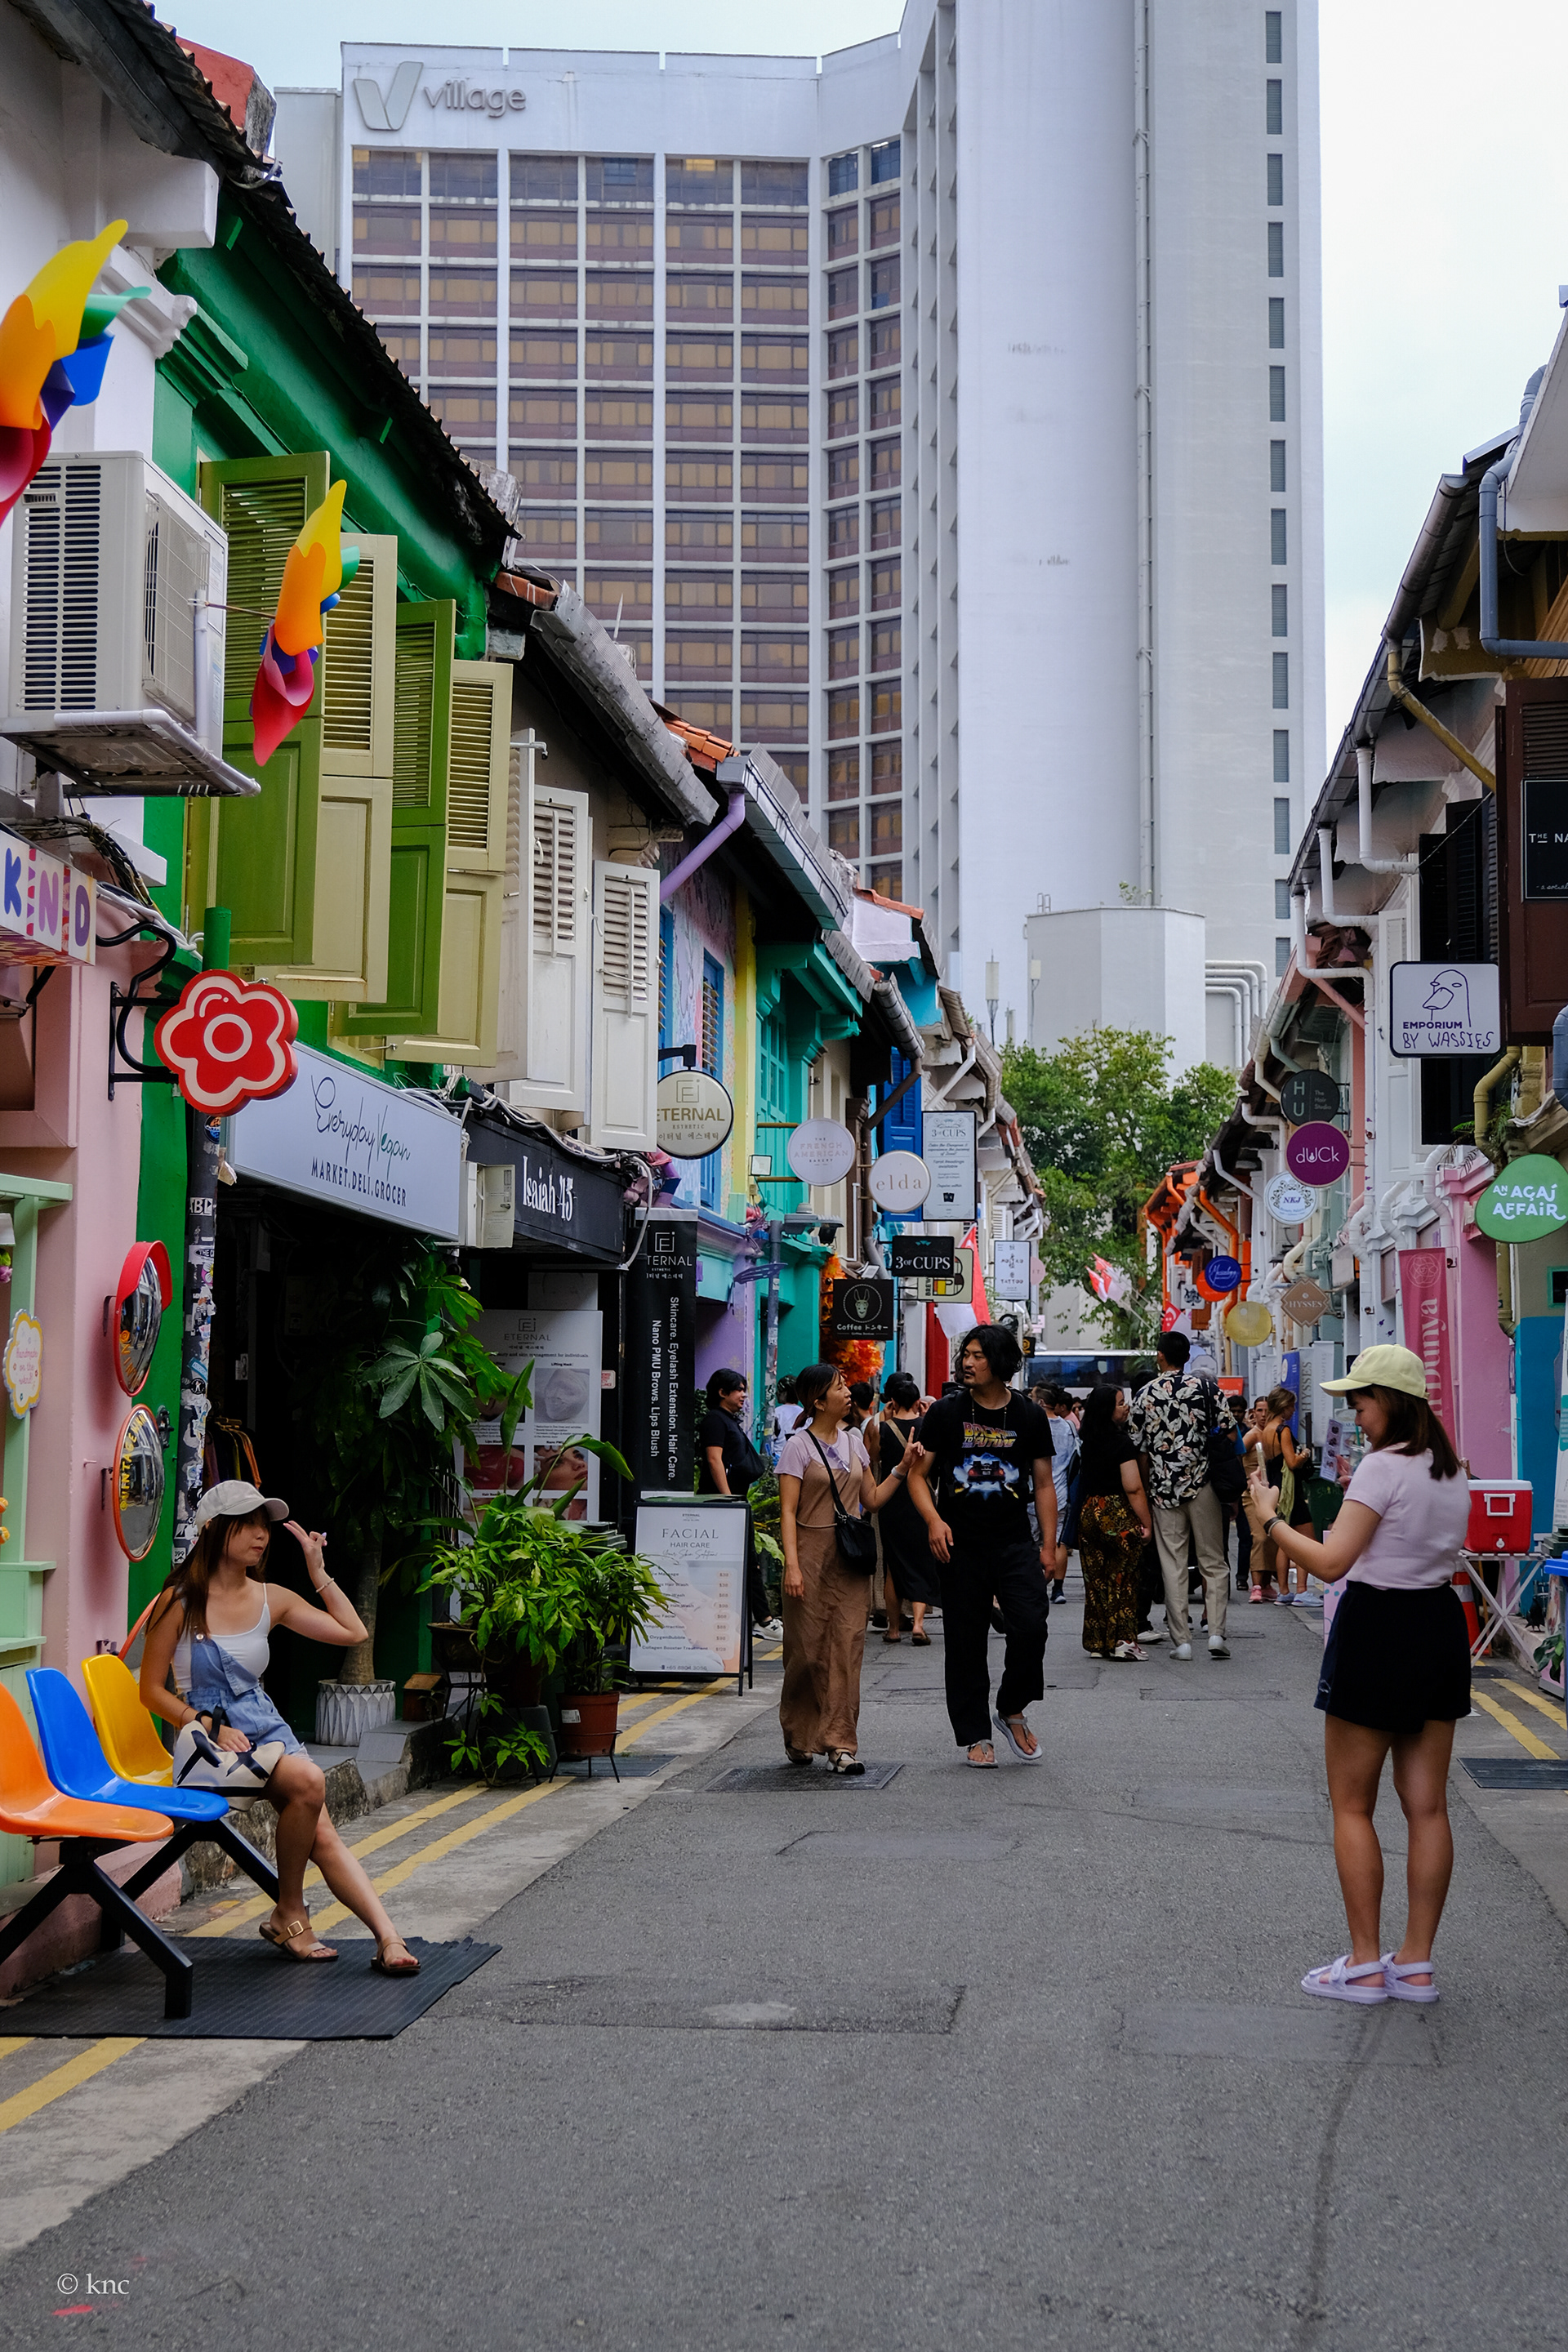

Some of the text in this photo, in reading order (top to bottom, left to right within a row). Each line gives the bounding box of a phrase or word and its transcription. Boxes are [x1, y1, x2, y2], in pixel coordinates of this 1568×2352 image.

[424, 79, 527, 118] village
[1402, 1021, 1463, 1030] EMPORIUM
[1402, 1031, 1494, 1049] BY WASSIES
[310, 1074, 411, 1182] Everyday Vegan
[931, 1129, 938, 1138] 3
[942, 1129, 966, 1138] CUPS
[800, 1141, 843, 1150] FRENCH
[793, 1150, 849, 1158] AMERICAN
[523, 1155, 556, 1214] Isaiah
[875, 1174, 923, 1192] elda
[1492, 1184, 1508, 1196] AN
[1283, 1196, 1303, 1205] NKJ
[647, 1255, 693, 1267] TERNAL
[895, 1255, 904, 1270] 3
[912, 1256, 951, 1270] CUPS
[1288, 1299, 1323, 1308] HYSSES
[652, 1319, 662, 1345] Nano
[836, 1323, 862, 1331] Coffee
[504, 1333, 551, 1341] ETERNAL
[651, 1347, 662, 1369] PMU
[669, 1343, 679, 1380] Eyelash
[1301, 1361, 1312, 1412] HYSSES
[650, 1406, 661, 1428] Lips
[1320, 1412, 1328, 1435] WHEN
[650, 1429, 661, 1458] Blush
[667, 1434, 679, 1453] Hair
[973, 1436, 1017, 1448] FUTURE
[662, 1528, 719, 1539] FACIAL
